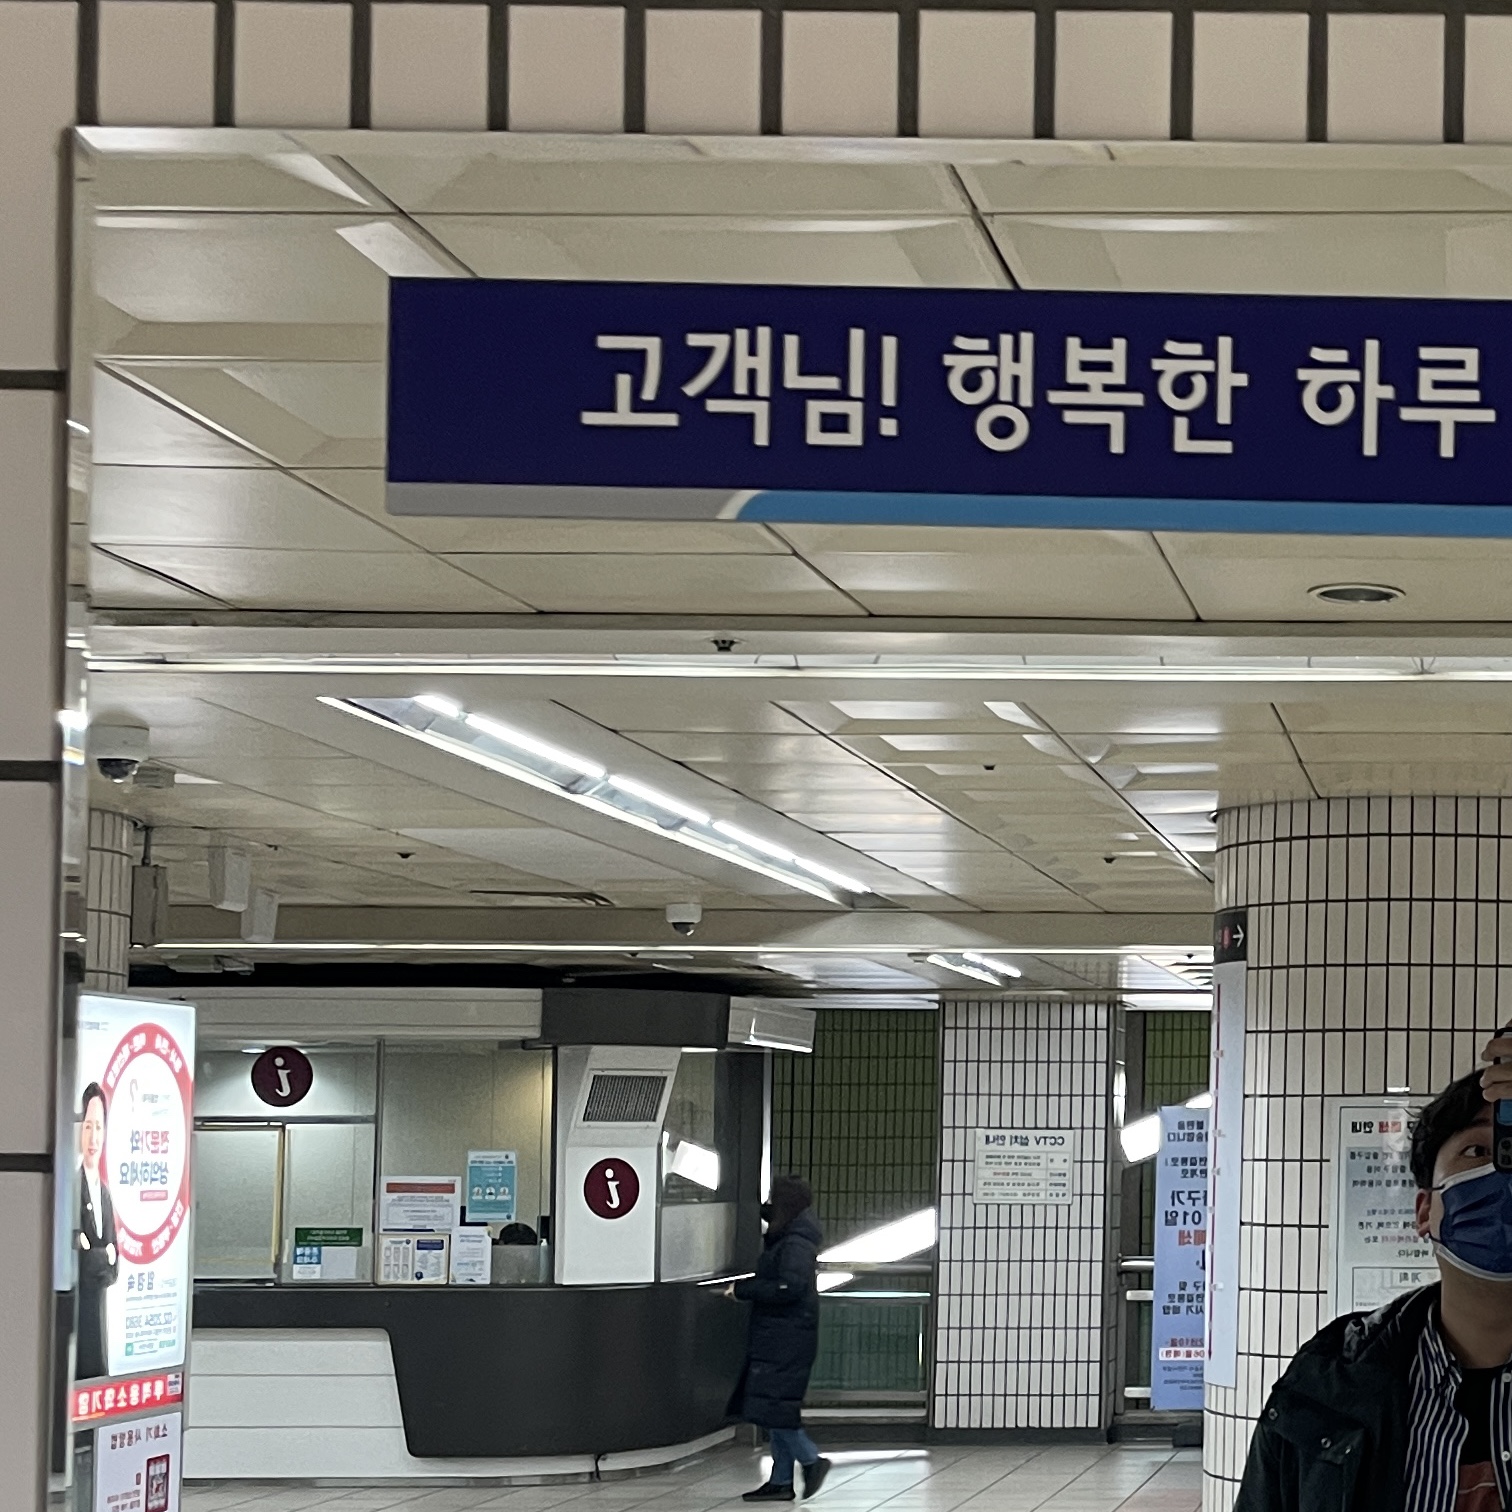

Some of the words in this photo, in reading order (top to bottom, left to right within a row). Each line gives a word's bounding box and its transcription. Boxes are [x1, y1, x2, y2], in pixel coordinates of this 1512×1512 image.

[580, 325, 898, 447] 고객님!
[942, 330, 1249, 454] 행복한
[1295, 338, 1497, 459] 하루
